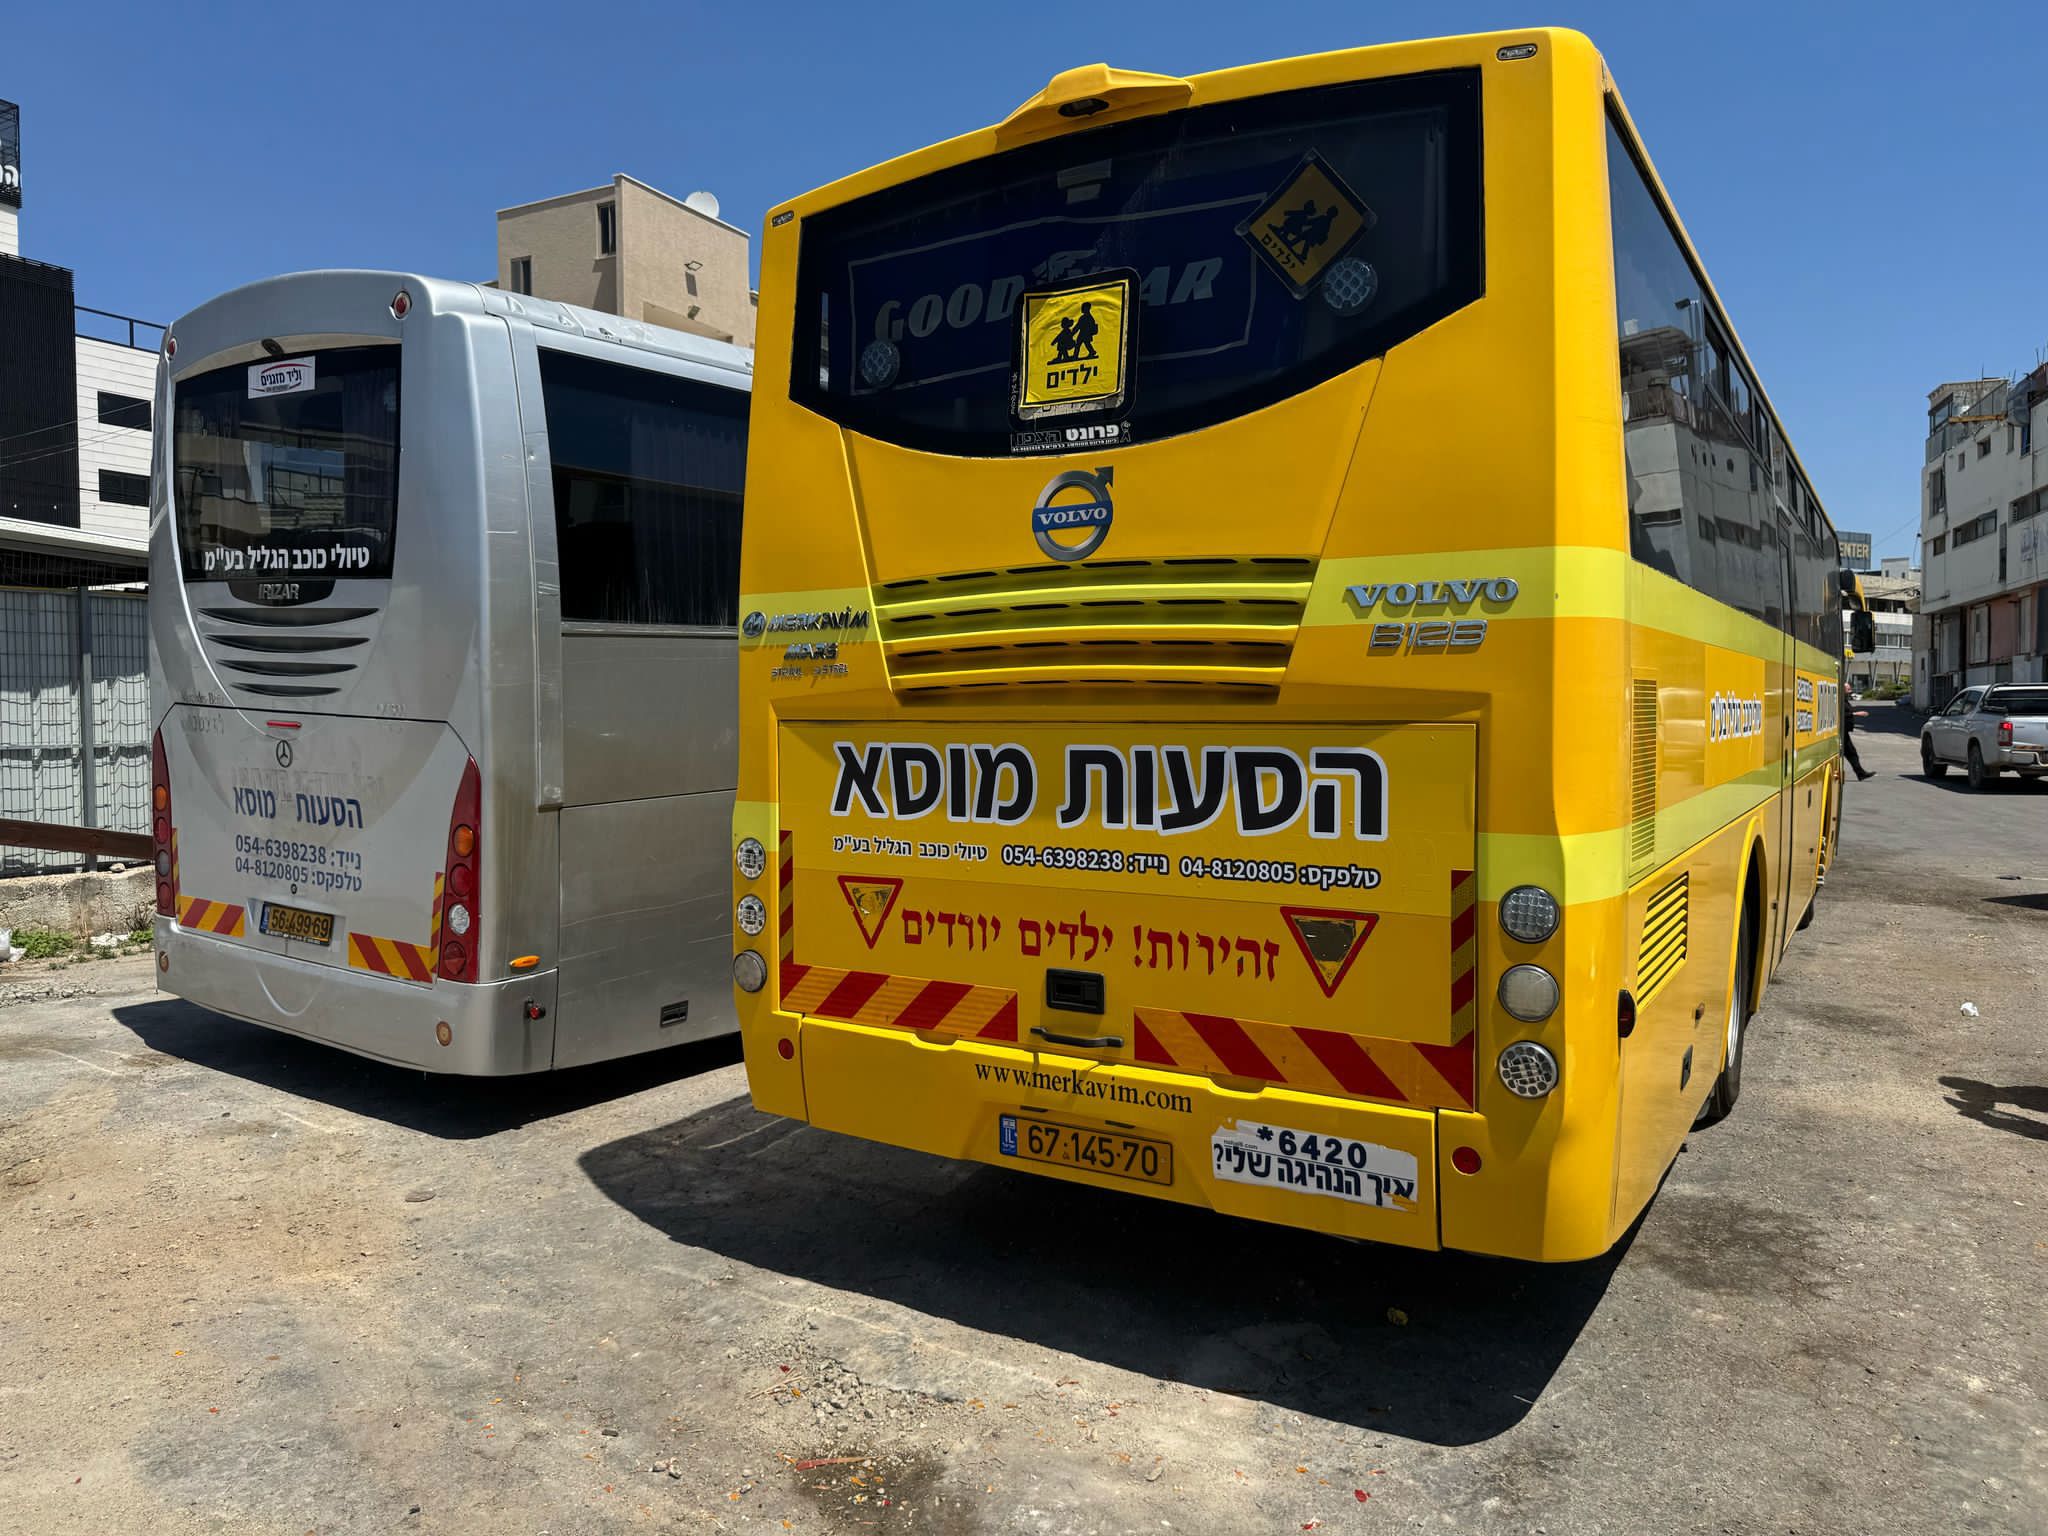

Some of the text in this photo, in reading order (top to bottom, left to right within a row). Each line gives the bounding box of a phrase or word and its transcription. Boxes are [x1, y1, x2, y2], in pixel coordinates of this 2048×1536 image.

[1261, 233, 1296, 269] ילדים
[874, 257, 1223, 343] GOODAR
[1046, 364, 1098, 389] ילדים
[1066, 424, 1120, 441] פרונט
[1038, 507, 1107, 525] VOLVO
[247, 545, 289, 570] הגליל
[292, 548, 327, 570] כוכב
[331, 543, 370, 569] טיולי
[1839, 542, 1869, 559] ENTER
[258, 583, 300, 600] IRIZAR
[1344, 577, 1519, 608] VOLVO
[1369, 619, 1488, 648] B12B
[830, 742, 1388, 840] הסעות מוסא
[233, 786, 363, 829] הסעות מוסא
[235, 834, 327, 866] 054-6398238
[873, 836, 912, 856] הגליל
[919, 841, 950, 859] כוכב
[953, 842, 988, 860] טיולי
[235, 856, 363, 893] טלפקס: 04-8120805
[1001, 845, 1382, 891] טלפקס: 04-8120805 נייד: 054-6398238
[901, 908, 1281, 982] זהירות! ילדים יורדים
[975, 1063, 1193, 1113] www.merkavim.com
[1213, 1143, 1415, 1206] איך הנהיגה שלי?
